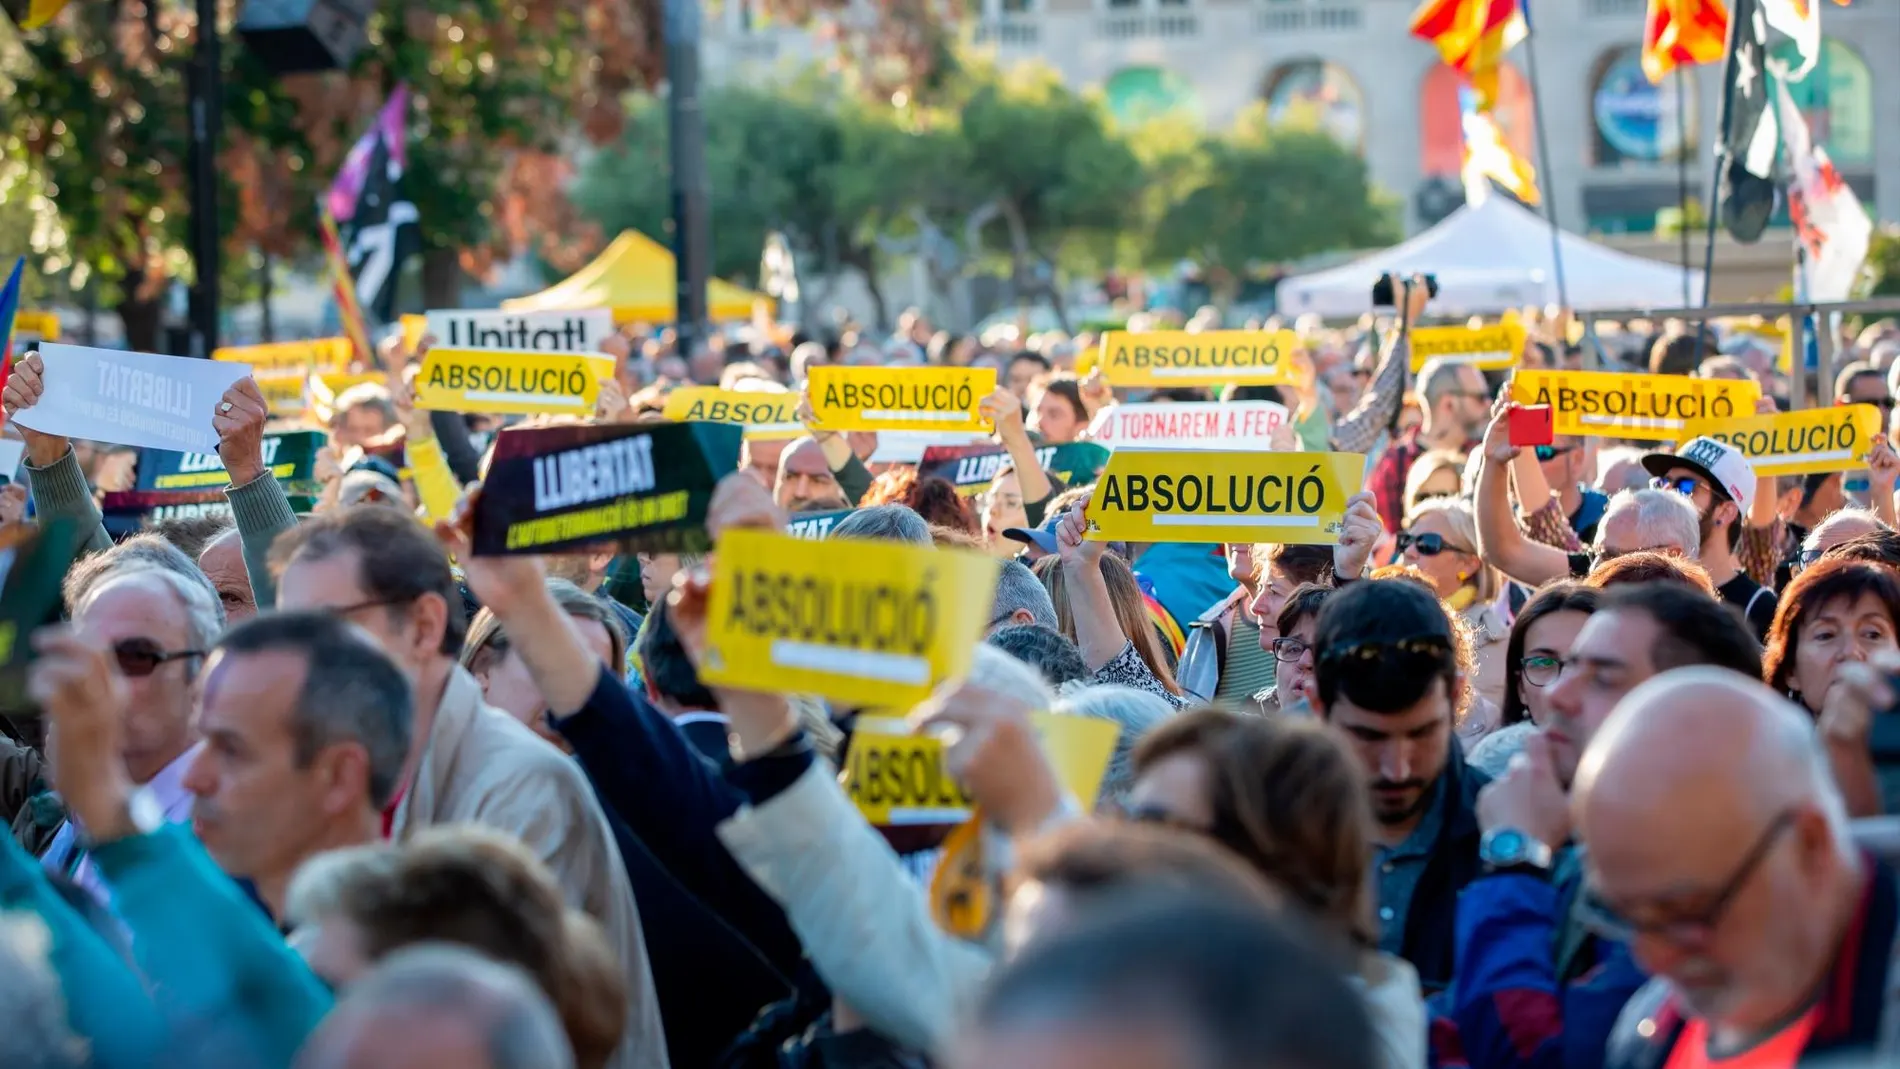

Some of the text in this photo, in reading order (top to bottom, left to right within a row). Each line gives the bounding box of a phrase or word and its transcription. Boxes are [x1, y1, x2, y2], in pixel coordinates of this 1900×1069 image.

[450, 318, 586, 350] Unitat!
[1112, 339, 1280, 368] ABSOLUCIÓ
[428, 362, 586, 395] ABSOLUCIÓ
[823, 377, 972, 409] ABSOLUCIÓ
[1534, 387, 1734, 418] ABSOLUCIÓ
[1096, 410, 1281, 440] O TORNAREM A FER
[1696, 414, 1856, 456] SOLUCIÓ
[532, 432, 656, 512] LLIBERTAT
[1101, 464, 1325, 514] ABSOLUCIÓ
[725, 564, 939, 657] ABSOLUCIÓ
[848, 747, 971, 805] ABSOL
